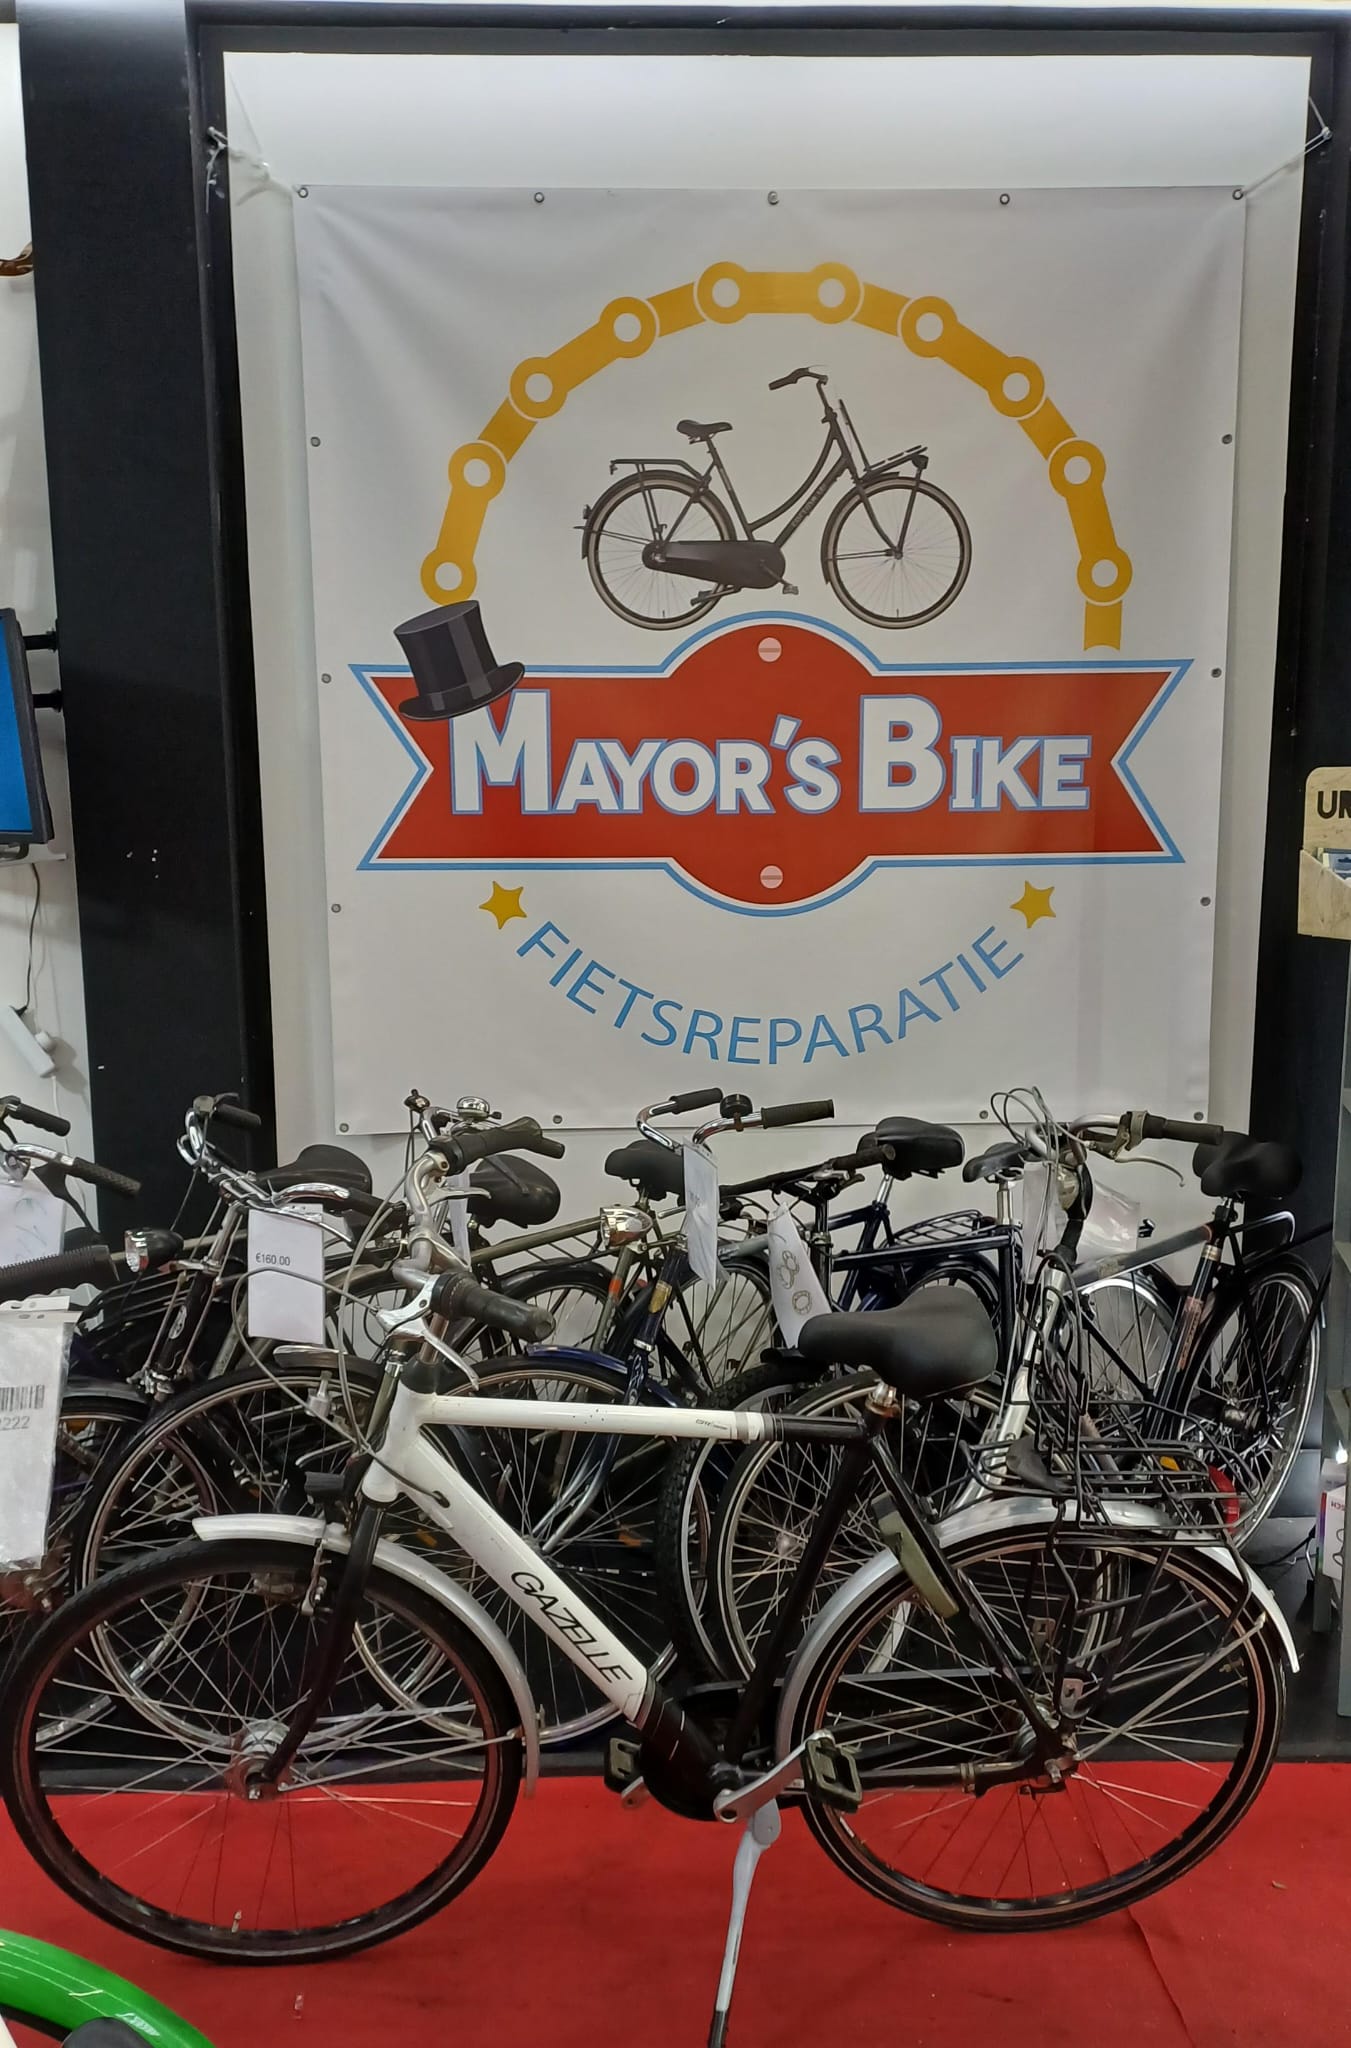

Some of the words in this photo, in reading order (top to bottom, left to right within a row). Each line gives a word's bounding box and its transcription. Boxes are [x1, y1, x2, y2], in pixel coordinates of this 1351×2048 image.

[450, 688, 842, 816] MAYOR'S
[857, 692, 1094, 815] BIKE
[516, 922, 1022, 1066] FIETSREPARATIE
[255, 1252, 291, 1267] €160.00
[0, 1415, 30, 1431] 222
[511, 1571, 633, 1684] GAZELLE
